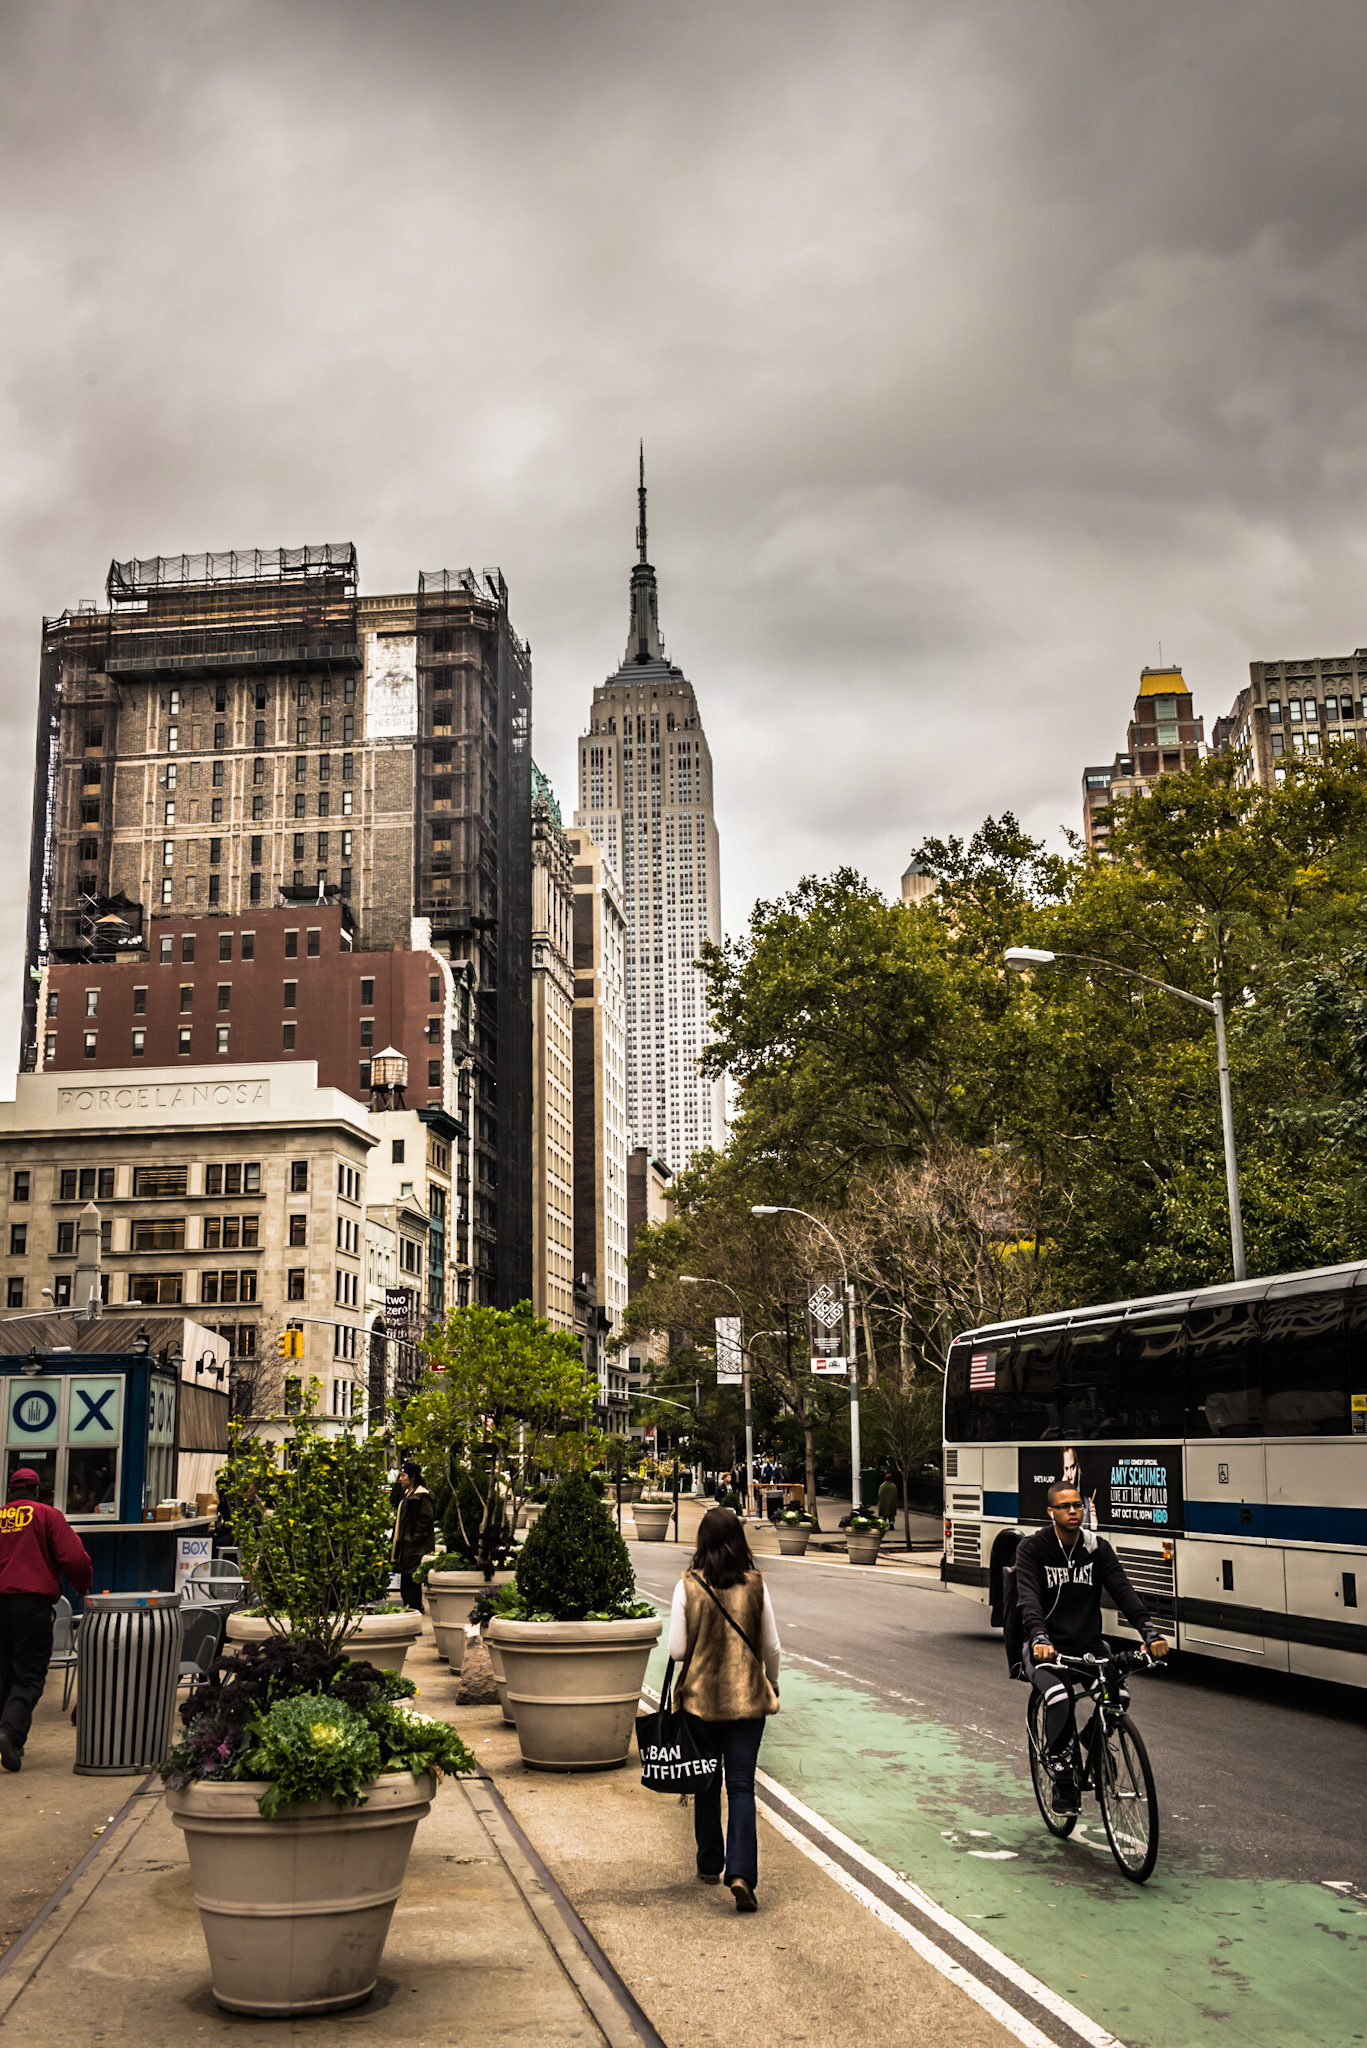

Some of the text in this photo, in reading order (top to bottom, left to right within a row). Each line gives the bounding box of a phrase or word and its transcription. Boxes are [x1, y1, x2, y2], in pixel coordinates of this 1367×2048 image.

[60, 1084, 268, 1112] PORCELANOSA
[386, 1294, 406, 1305] two
[386, 1306, 408, 1316] zero
[816, 1303, 834, 1318] SQ.
[825, 1303, 844, 1325] KIDS
[1110, 1466, 1167, 1487] AMY SCHUMER
[1110, 1487, 1168, 1505] LIVE AT THE APOLLO
[0, 1517, 15, 1529] US
[1111, 1508, 1121, 1518] SAT
[1121, 1508, 1132, 1519] OCT
[1152, 1509, 1168, 1523] HBO
[182, 1541, 208, 1555] BOX
[641, 1758, 718, 1780] UTFITTERS
